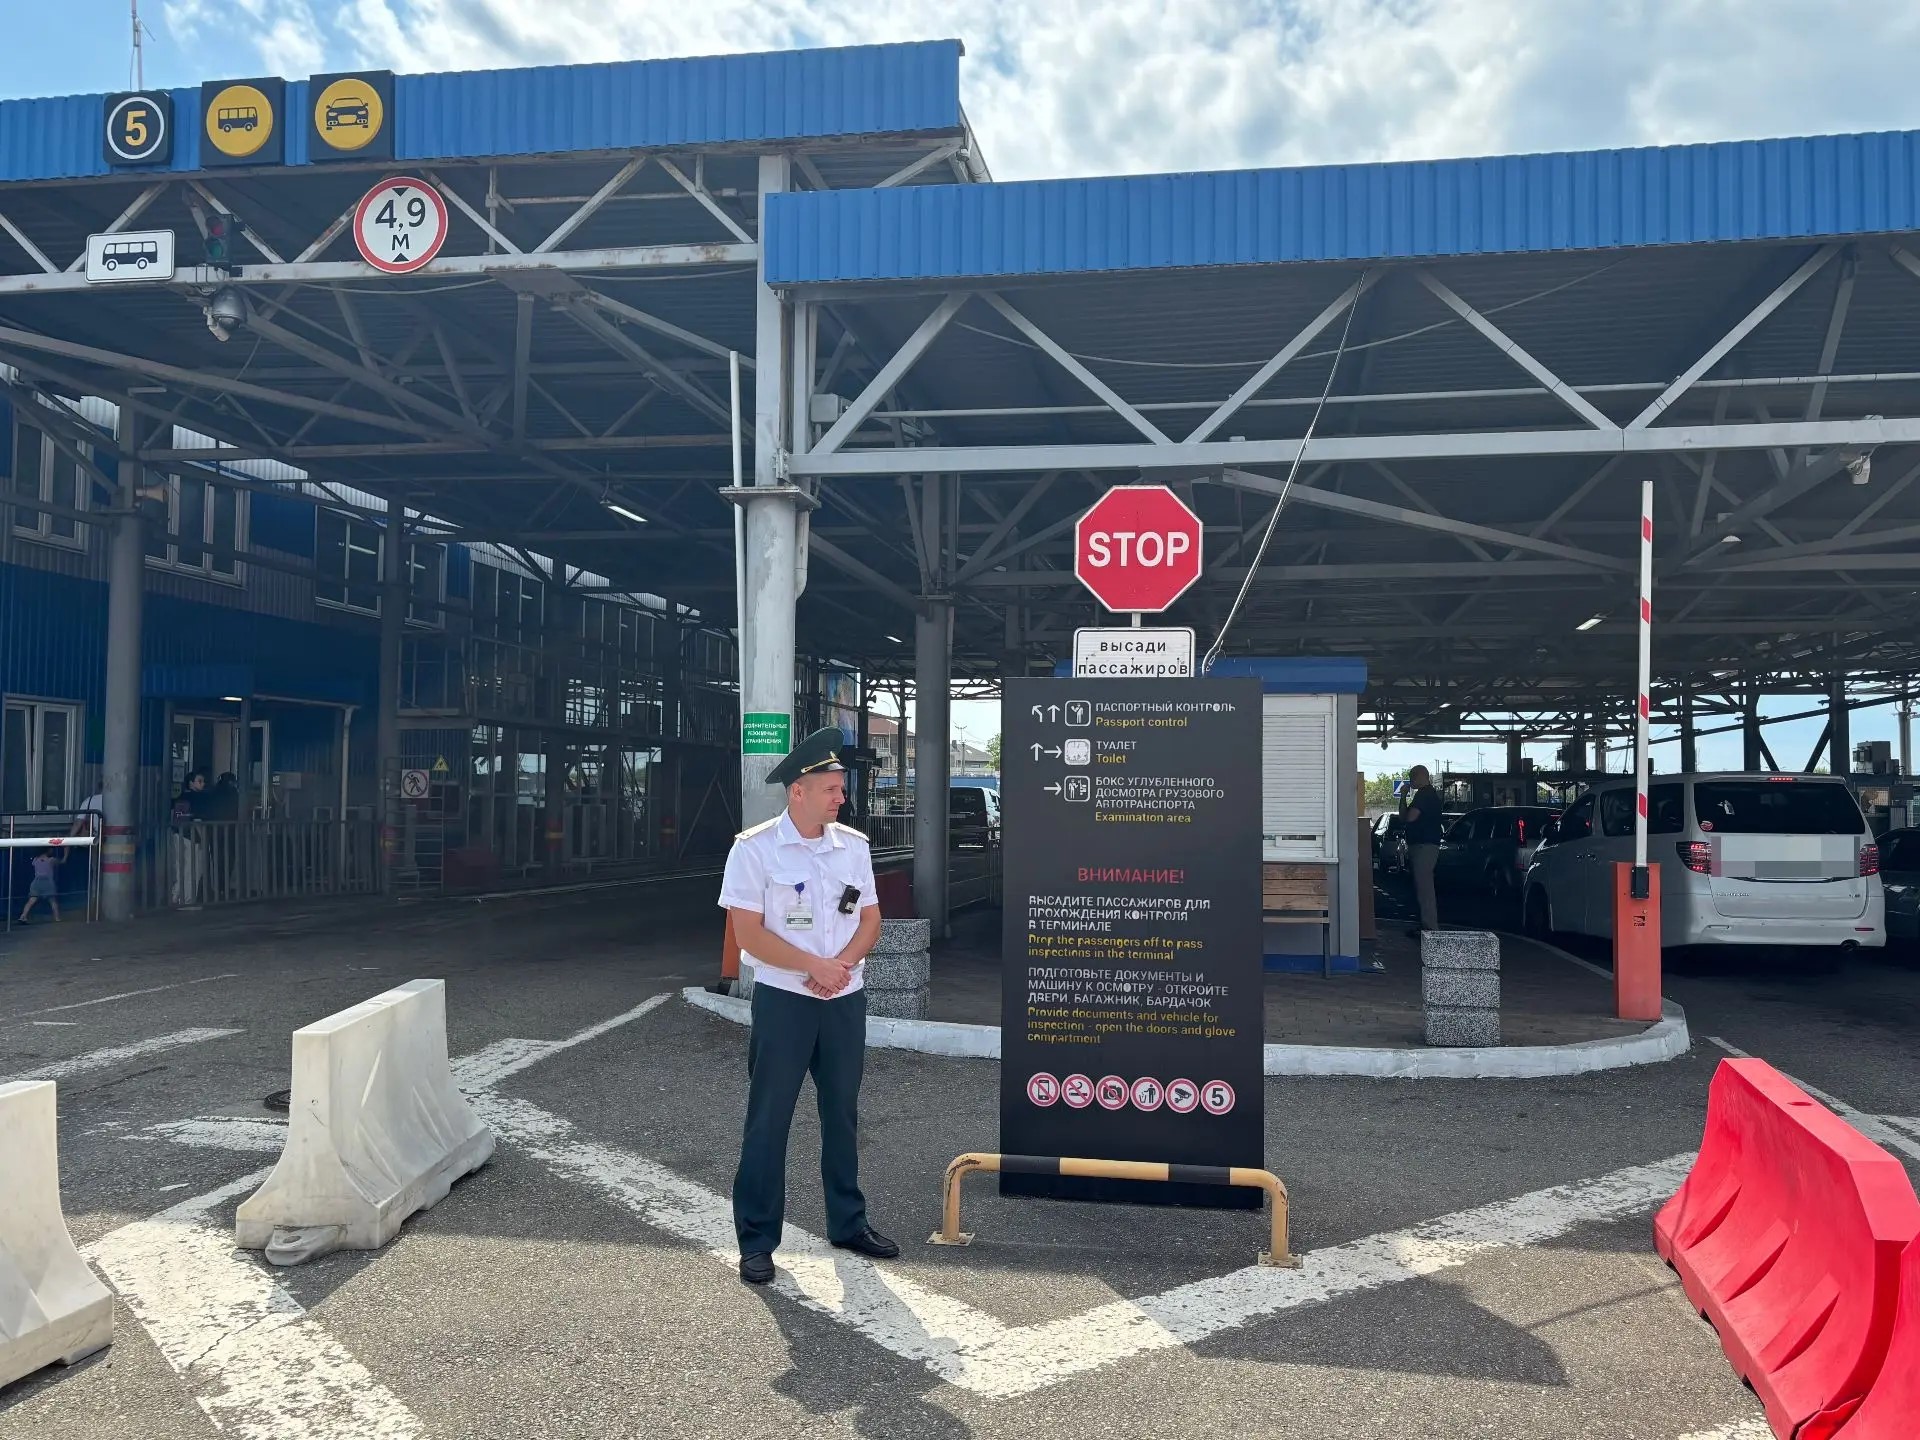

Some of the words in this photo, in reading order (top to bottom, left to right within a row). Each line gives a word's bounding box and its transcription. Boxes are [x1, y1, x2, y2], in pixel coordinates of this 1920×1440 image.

[125, 110, 147, 146] 5
[375, 197, 426, 231] 4,9
[1088, 531, 1190, 567] STOP
[1100, 641, 1166, 654] высади
[1078, 663, 1188, 678] пассажиров
[1095, 700, 1173, 712] ПАСПОРТНЫЙ
[1175, 702, 1236, 713] КОНТРОЛЬ
[1095, 716, 1145, 728] Passport
[1148, 716, 1188, 727] control
[1095, 740, 1137, 750] ТУАЛЕТ
[1095, 754, 1127, 764] Toilet
[1095, 777, 1125, 786] БОКС
[1127, 777, 1215, 787] УГЛУБЛЕННОГО
[1095, 788, 1156, 799] ДОСМОТРА
[1159, 789, 1224, 799] ГРУЗОВОГО
[1095, 800, 1195, 810] АВТОТРАНСПОРТА
[1095, 812, 1164, 822] Examination
[1167, 814, 1191, 823] area
[1077, 867, 1185, 884] ВНИМАНИЕ!
[1028, 895, 1093, 907] ВЫСАДИТЕ
[1096, 897, 1182, 909] ПАССАЖИРОВ
[1184, 899, 1211, 911] ДЛЯ
[1028, 908, 1121, 920] ПРОХОЖДЕНИЯ
[1124, 910, 1188, 921] КОНТРОЛЯ
[1028, 920, 1036, 930] В
[1040, 920, 1112, 932] ТЕРМИНАЛЕ
[1028, 934, 1052, 946] Drop
[1056, 935, 1074, 945] the
[1077, 937, 1140, 949] passengers
[1143, 937, 1159, 947] off
[1162, 938, 1174, 948] to
[1176, 940, 1203, 950] pass
[1028, 948, 1091, 960] inspections
[1094, 949, 1104, 958] in
[1107, 949, 1125, 959] the
[1127, 950, 1174, 960] terminal
[1028, 967, 1112, 980] ПОДГОТОВЬТЕ
[1114, 969, 1192, 982] ДОКУМЕНТЫ
[1195, 972, 1204, 982] И
[1028, 980, 1082, 991] МАШИНУ
[1085, 981, 1094, 991] К
[1096, 982, 1154, 993] ОСМОТРУ
[1165, 983, 1229, 995] ОТКРОЙТЕ
[1146, 996, 1212, 1008] БАРДАЧОК
[1027, 1006, 1069, 1018] Provide
[1072, 1008, 1134, 1020] documents
[1136, 1010, 1157, 1021] and
[1160, 1012, 1200, 1022] vehicle
[1203, 1013, 1219, 1023] for
[1027, 1020, 1085, 1033] inspection
[1095, 1024, 1123, 1034] open
[1125, 1022, 1143, 1033] the
[1146, 1023, 1178, 1034] doors
[1181, 1025, 1202, 1035] and
[1205, 1025, 1236, 1037] glove
[1027, 1033, 1101, 1044] compartment
[1211, 1087, 1225, 1107] 5
